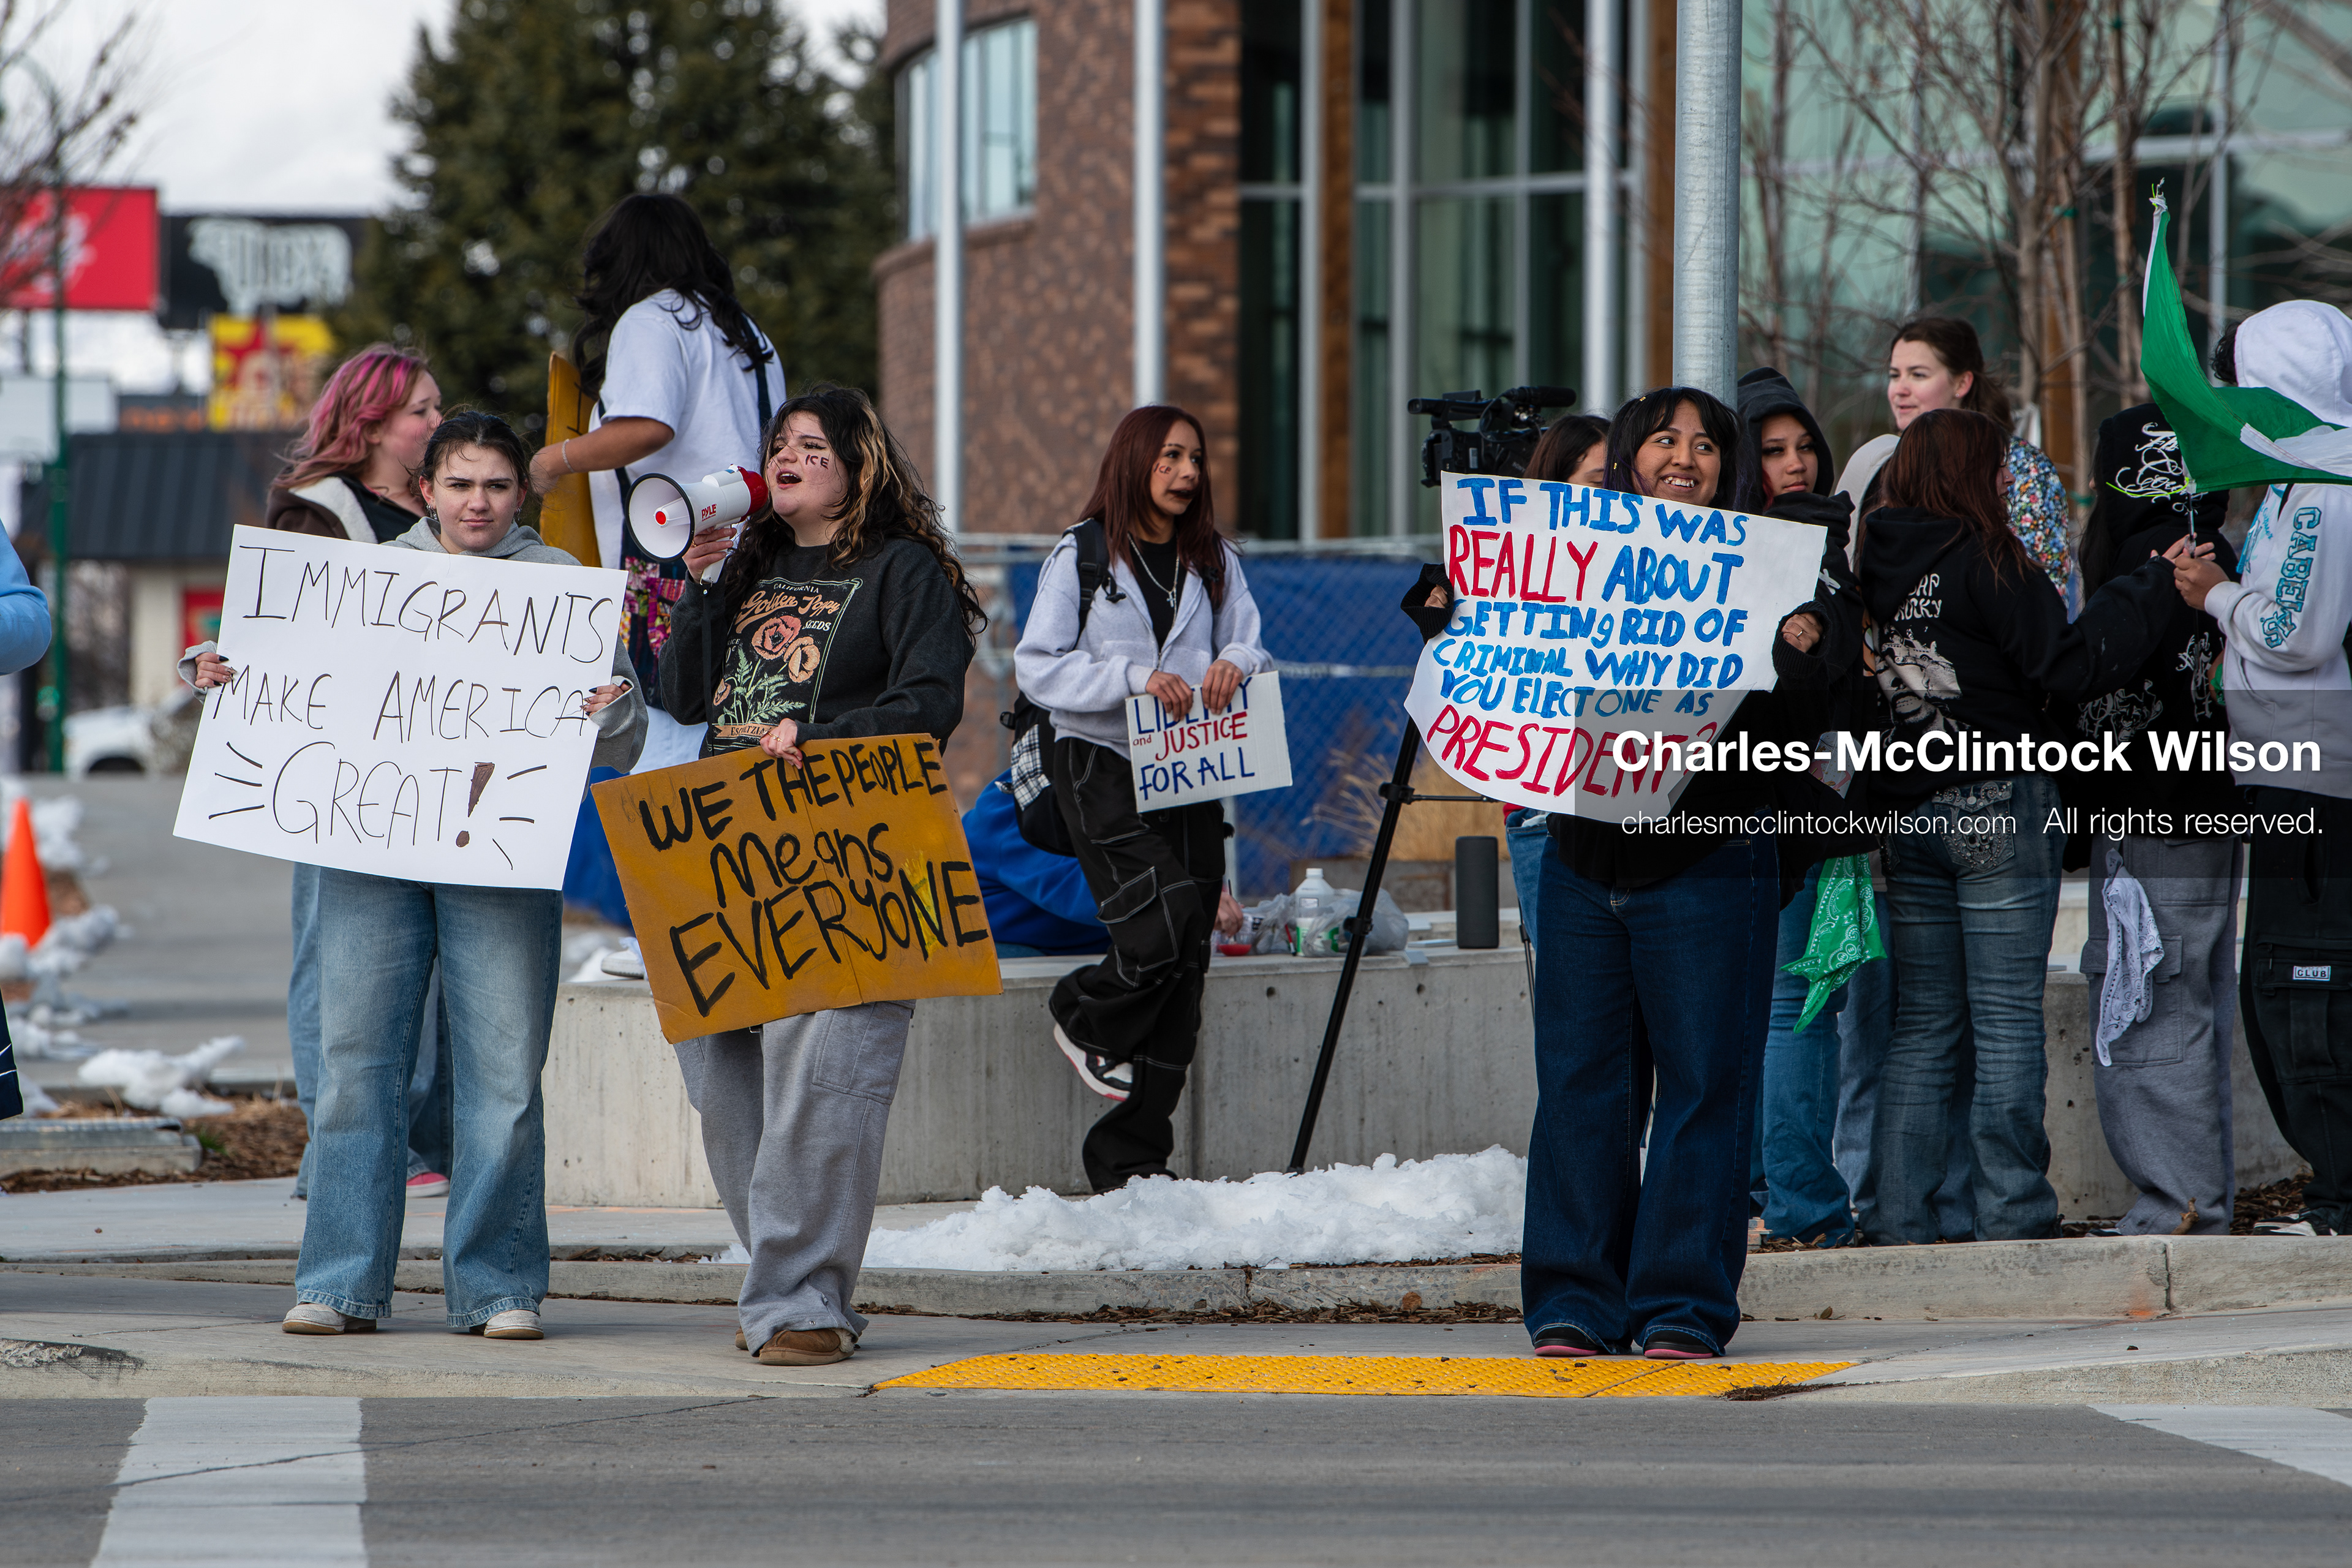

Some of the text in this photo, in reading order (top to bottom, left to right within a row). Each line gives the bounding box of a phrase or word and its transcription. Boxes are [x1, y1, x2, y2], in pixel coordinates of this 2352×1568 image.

[805, 454, 829, 470] ICE
[701, 503, 717, 519] PYLE
[1457, 477, 1749, 546] IF THIS WAS
[774, 583, 820, 594] CALIFORNIA
[1449, 524, 1744, 605] REALLY ABOUT
[239, 545, 613, 664] IMMIGRANTS
[735, 590, 841, 633] Golden Poppy
[802, 619, 832, 631] SEEDS
[1619, 608, 1686, 647] RID
[1694, 608, 1748, 647] OF
[1433, 638, 1743, 690] CRIMINAL WHY DID
[212, 665, 589, 744] MAKE AMERICA
[1441, 669, 1714, 718] YOU ELECT ONE AS
[1133, 711, 1248, 761] and JUSTICE
[272, 741, 496, 850] GREAT!
[638, 738, 948, 852] WE THE PEOPLE
[1139, 747, 1255, 801] FOR ALL
[2297, 969, 2327, 978] CLUB
